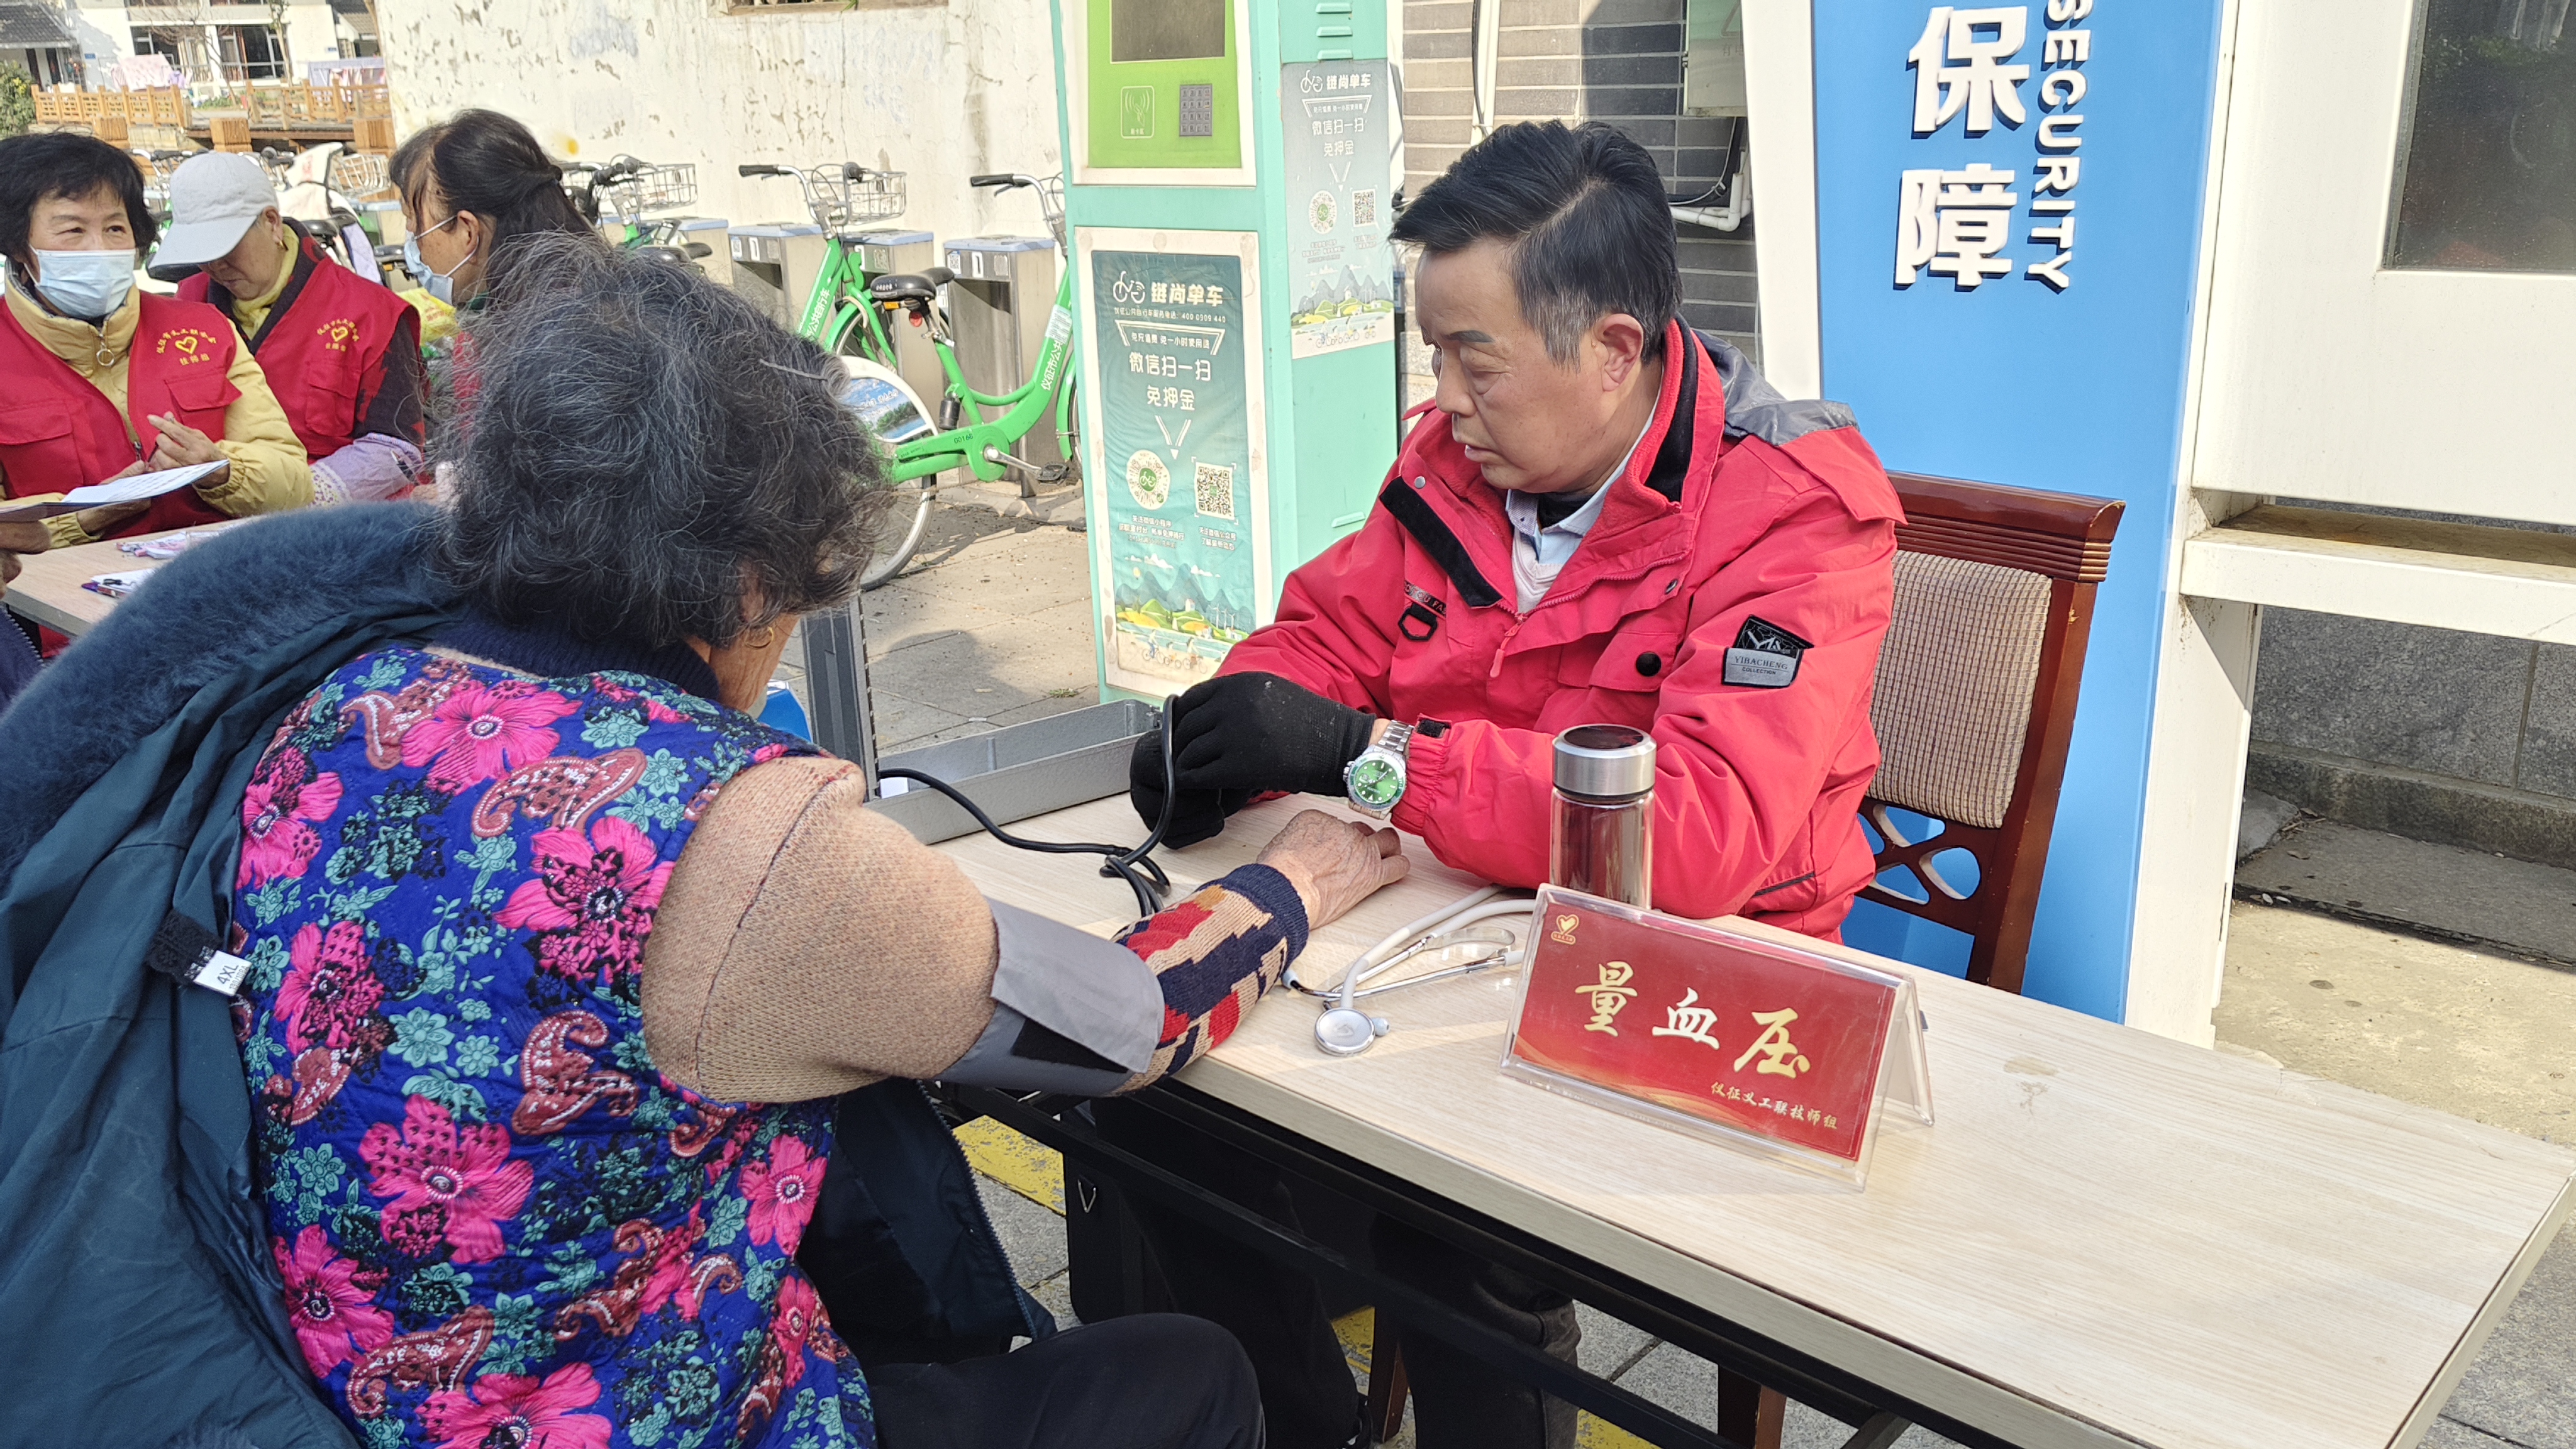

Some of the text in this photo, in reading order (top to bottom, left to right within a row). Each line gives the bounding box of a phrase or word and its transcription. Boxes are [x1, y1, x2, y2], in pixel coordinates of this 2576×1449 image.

[1312, 117, 1364, 136] 微信扫一扫
[1323, 140, 1354, 157] 免押金
[1895, 6, 2030, 286] 保障
[2028, 0, 2093, 288] SECURITY
[1182, 313, 1194, 321] 400
[1196, 314, 1212, 322] 0909
[1214, 315, 1226, 323] 440
[1129, 351, 1211, 382] 微信扫一扫
[1146, 384, 1196, 411] 免押金
[1735, 655, 1788, 670] YIBACHENG
[1742, 667, 1777, 675] COLLECTION
[217, 964, 239, 985] 4XL
[1575, 960, 1811, 1079] 量血压
[1711, 1081, 1838, 1130] 仪征义工联技师组
